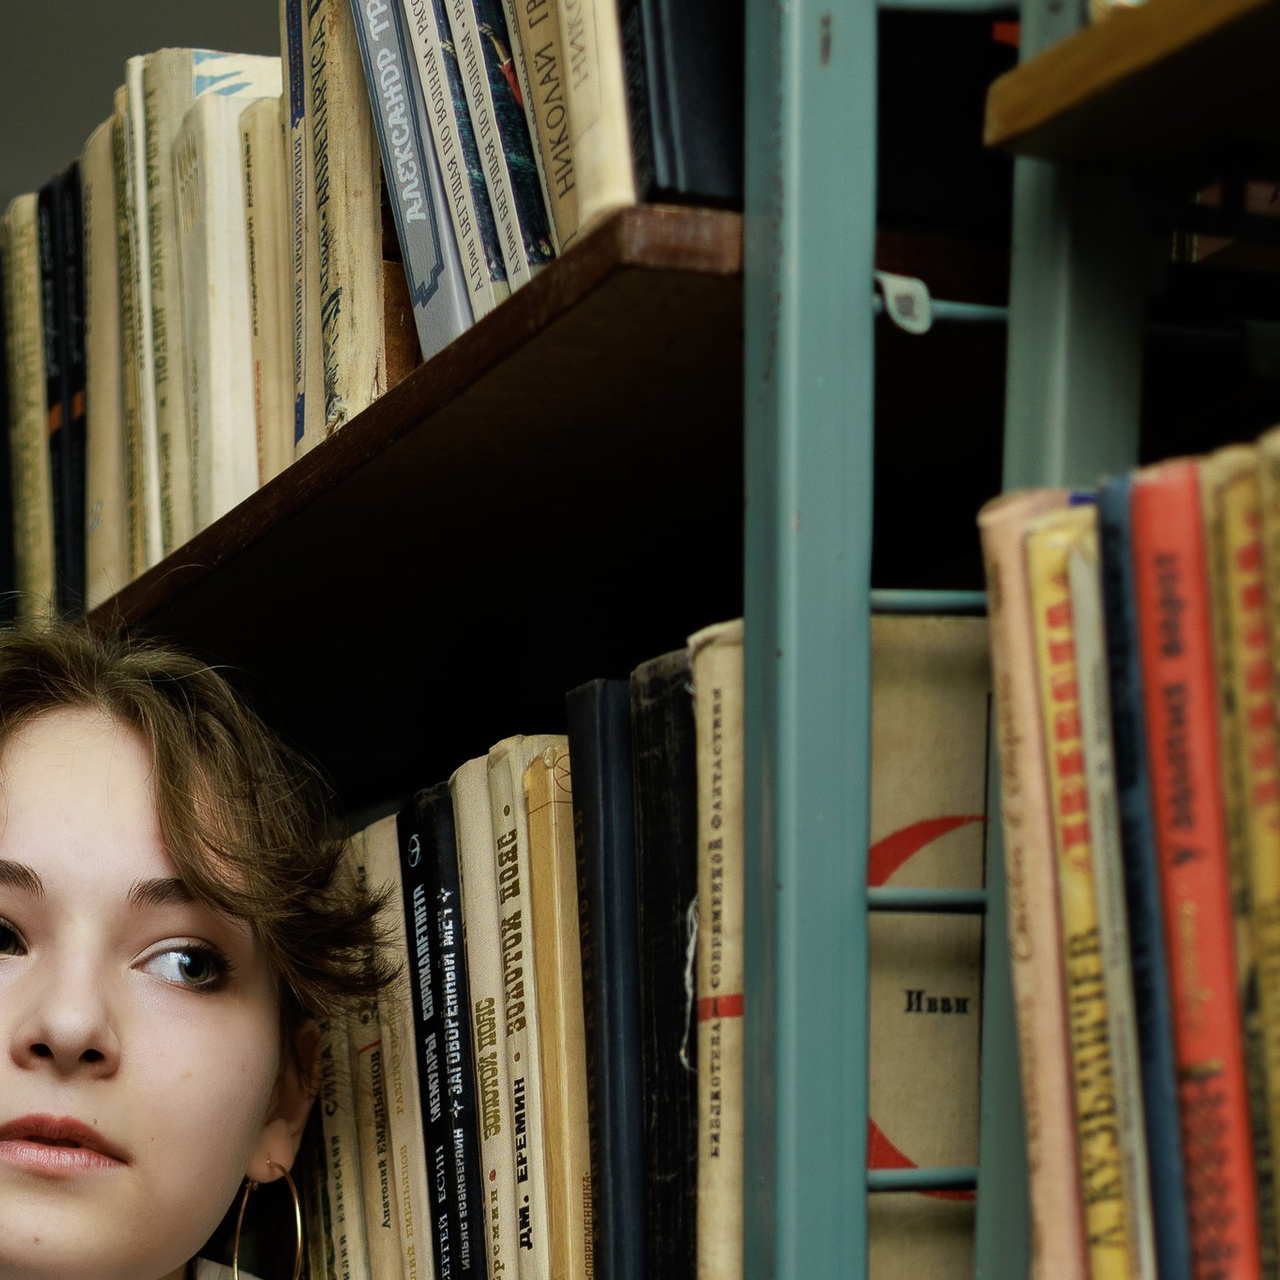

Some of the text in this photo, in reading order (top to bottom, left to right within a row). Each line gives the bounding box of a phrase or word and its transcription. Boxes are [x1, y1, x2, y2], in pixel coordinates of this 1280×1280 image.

[422, 47, 446, 125] ВОЛНАМ
[460, 29, 485, 106] ВОЛНАМ
[376, 49, 426, 223] АЛЕКСАНДР
[440, 126, 455, 153] ПО
[476, 108, 491, 137] ПО
[532, 42, 575, 200] НИКОЛАЙ
[446, 155, 471, 238] БЕГУЩАЯ
[485, 139, 509, 219] БЕГУЩАЯ
[475, 997, 496, 1051] ПОЯС
[497, 829, 532, 1250] ДМ. ЕРЕМИН ЗОЛОТОЙ ПОЯС
[906, 989, 970, 1013] Иван
[425, 1032, 441, 1122] МЕМУАРЫ
[477, 1053, 500, 1139] ЗОЛОТОЙ
[370, 1052, 391, 1230] Анатолий ЕМЕЛЬЯНОВ
[435, 1145, 446, 1204] ЕСИН
[400, 1145, 414, 1238] ЕМЕЛЬЯНОВ
